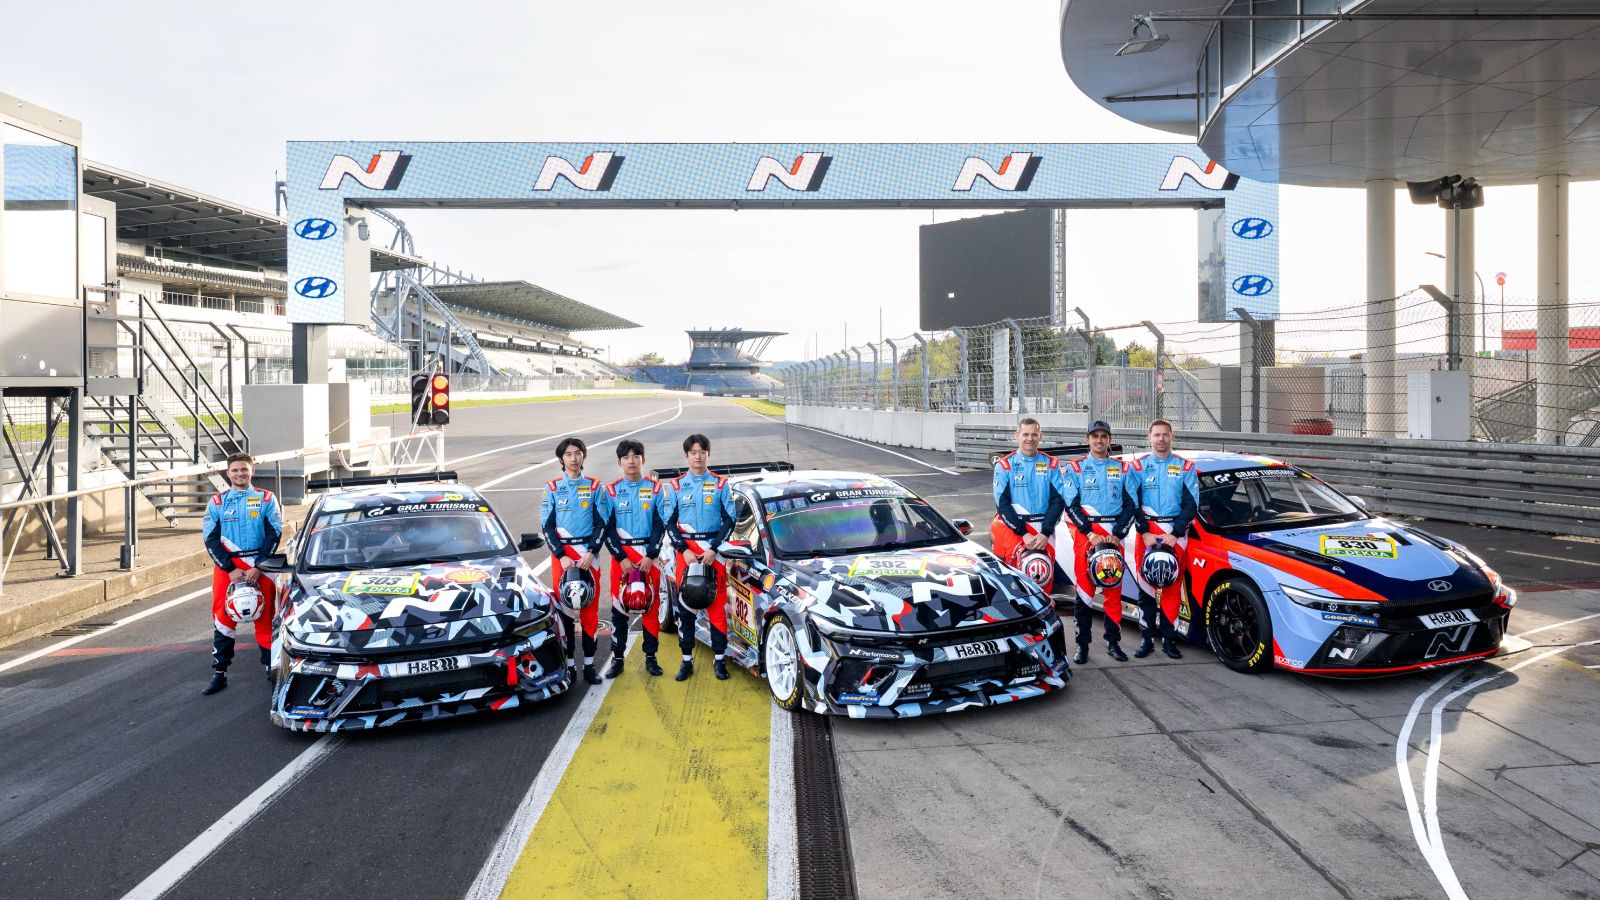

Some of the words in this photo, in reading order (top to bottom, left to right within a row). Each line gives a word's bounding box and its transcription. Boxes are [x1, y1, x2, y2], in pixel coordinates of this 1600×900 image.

[318, 150, 413, 190] N
[532, 151, 626, 191] N
[745, 151, 833, 191] N
[951, 151, 1043, 191] N
[1260, 469, 1295, 477] TURISMO
[397, 503, 427, 512] GRAN
[1339, 540, 1378, 550] 830
[1345, 550, 1389, 558] DEKRA
[870, 560, 907, 569] 302
[362, 576, 402, 585] 303
[735, 596, 749, 625] 302
[1324, 614, 1375, 625] GOODYEAR
[1428, 611, 1455, 626] H&R
[862, 650, 899, 659] Performance
[954, 641, 983, 658] H&R
[1248, 642, 1265, 667] EAGLE
[408, 660, 440, 674] H&R
[1274, 655, 1304, 667] sparco
